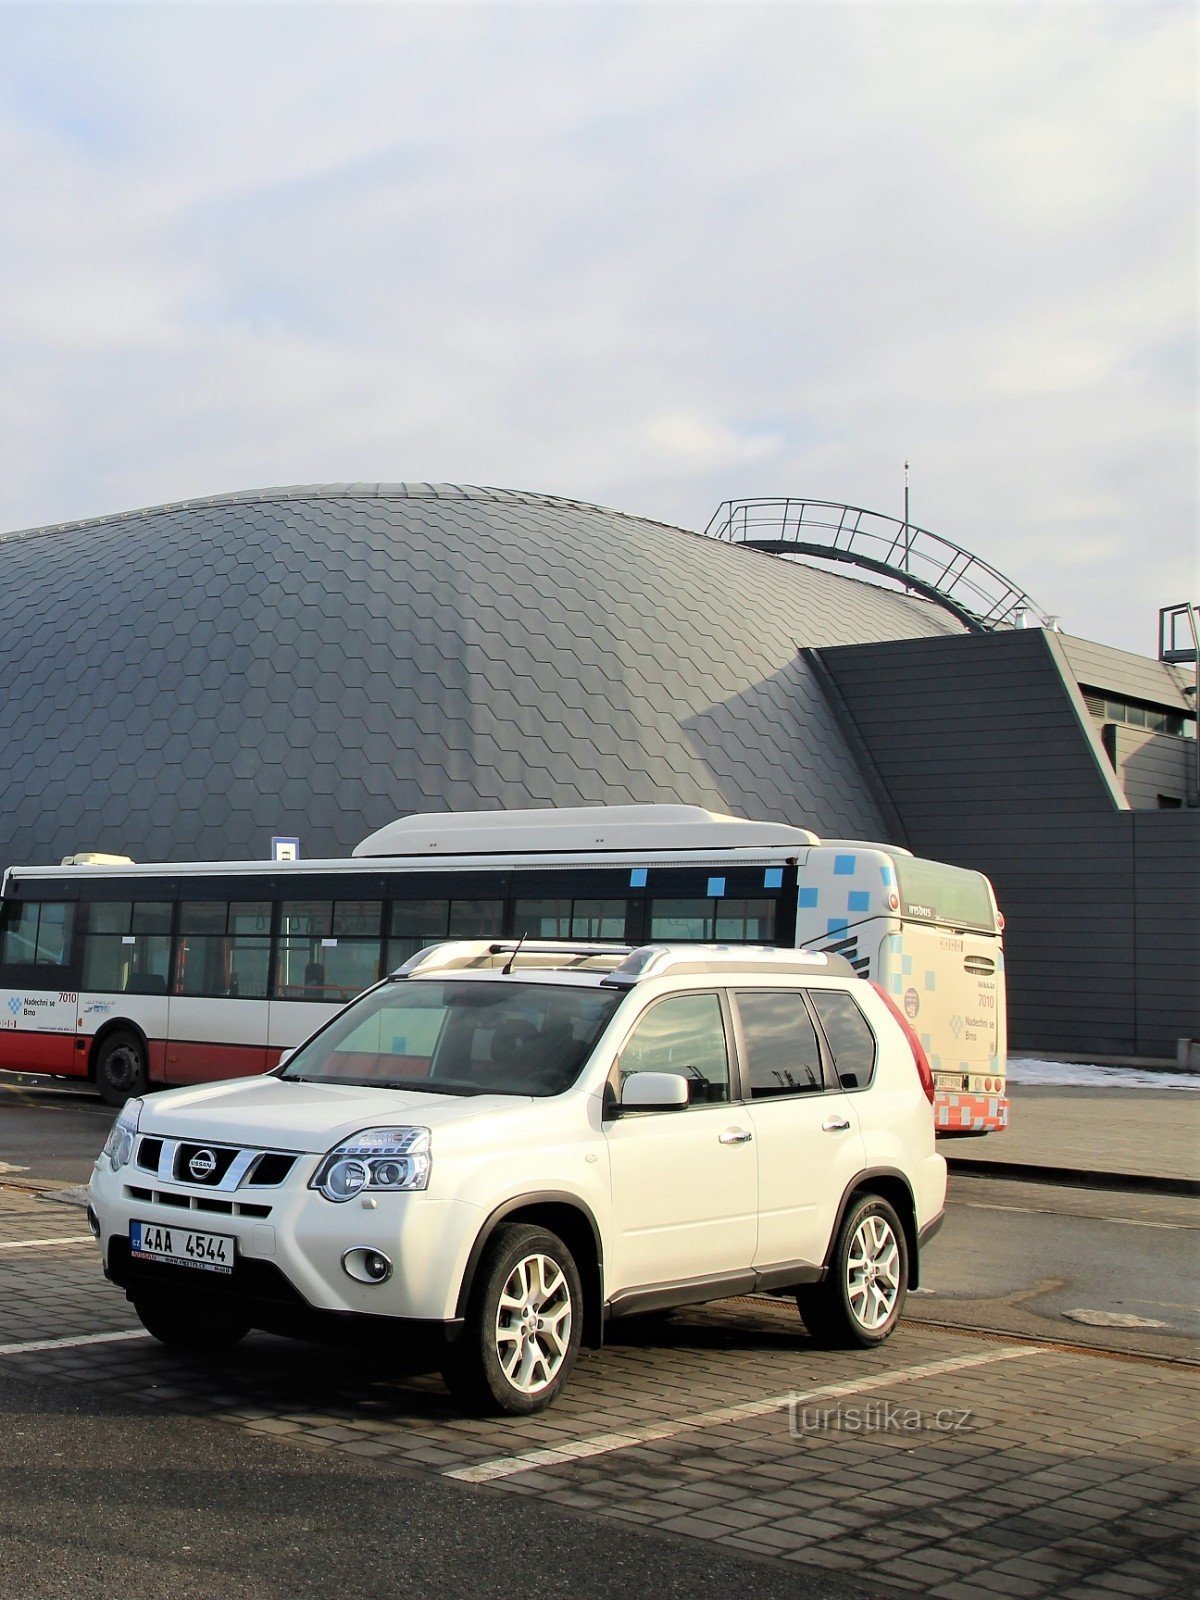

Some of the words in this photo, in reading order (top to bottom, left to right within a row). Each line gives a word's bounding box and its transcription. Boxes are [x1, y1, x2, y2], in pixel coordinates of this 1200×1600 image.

[59, 993, 76, 1003] 7010
[978, 993, 995, 1008] 7010
[145, 1228, 172, 1253] 4AA
[186, 1235, 225, 1261] 4544
